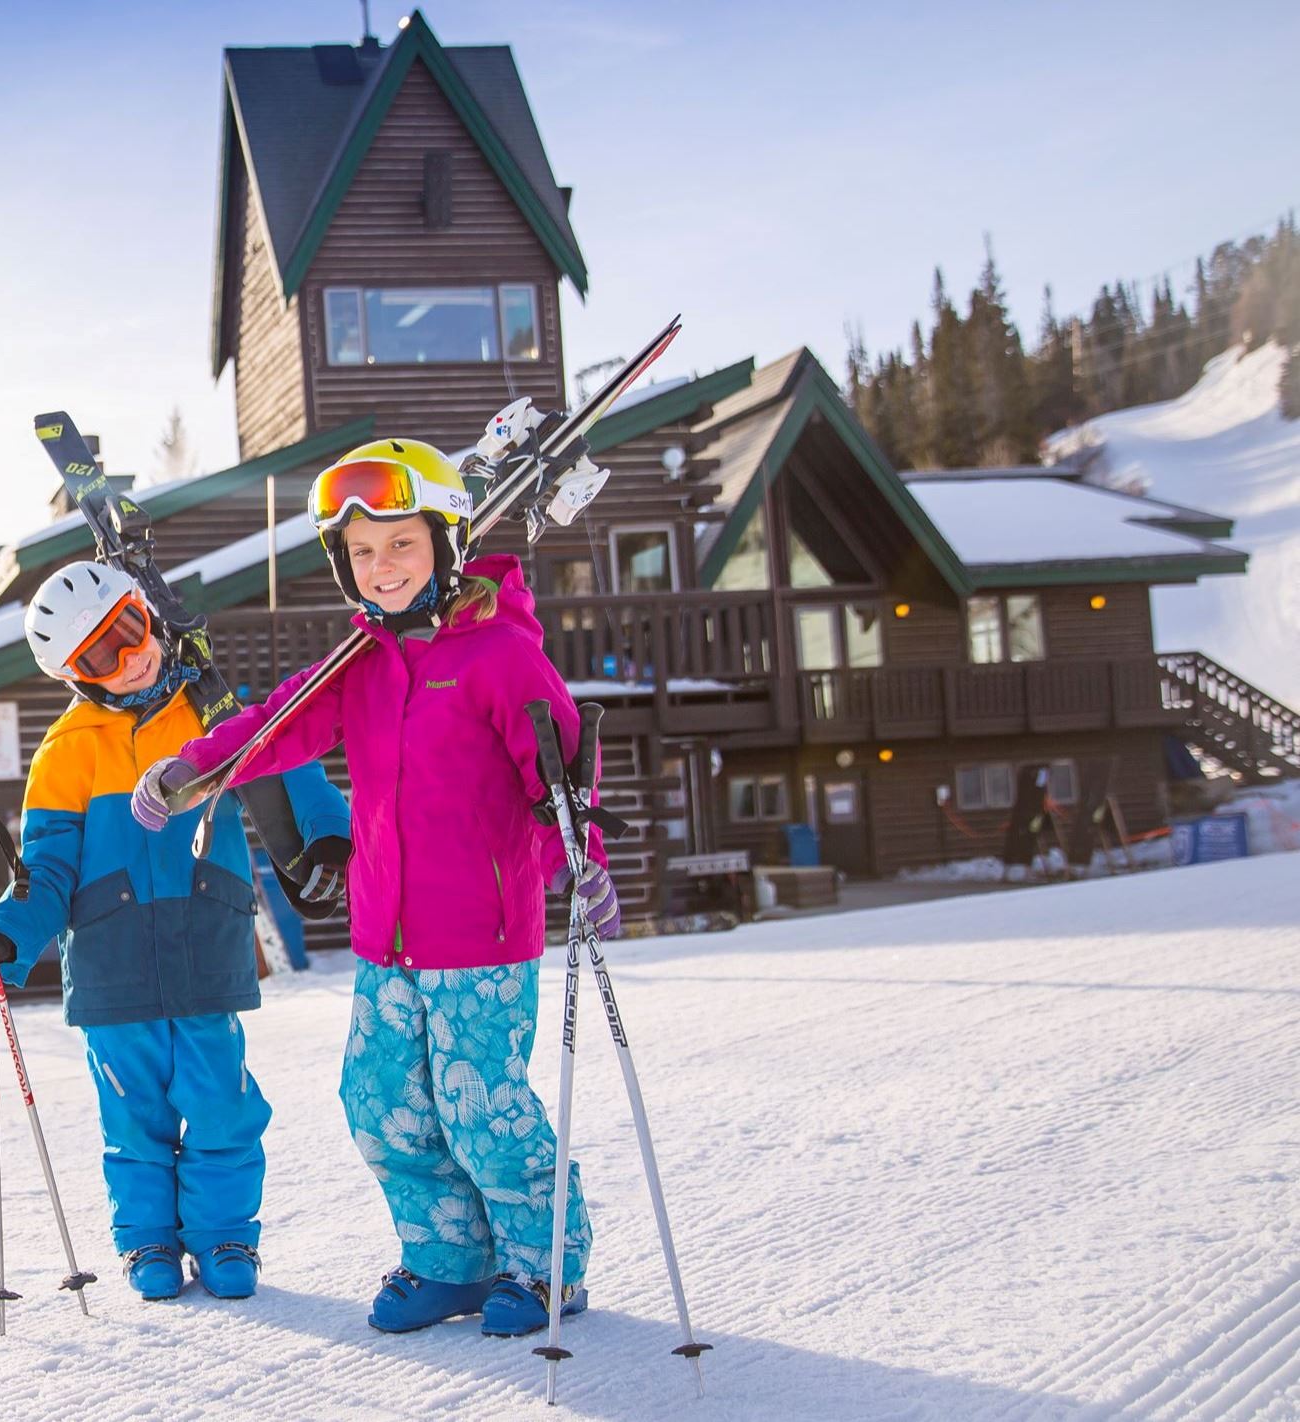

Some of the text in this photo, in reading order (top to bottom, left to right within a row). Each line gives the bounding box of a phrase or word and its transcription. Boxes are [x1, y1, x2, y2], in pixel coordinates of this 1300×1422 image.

[65, 462, 95, 476] 120
[425, 678, 458, 689] Marmot
[563, 973, 579, 1054] SCOTT
[595, 971, 628, 1048] SCOTT
